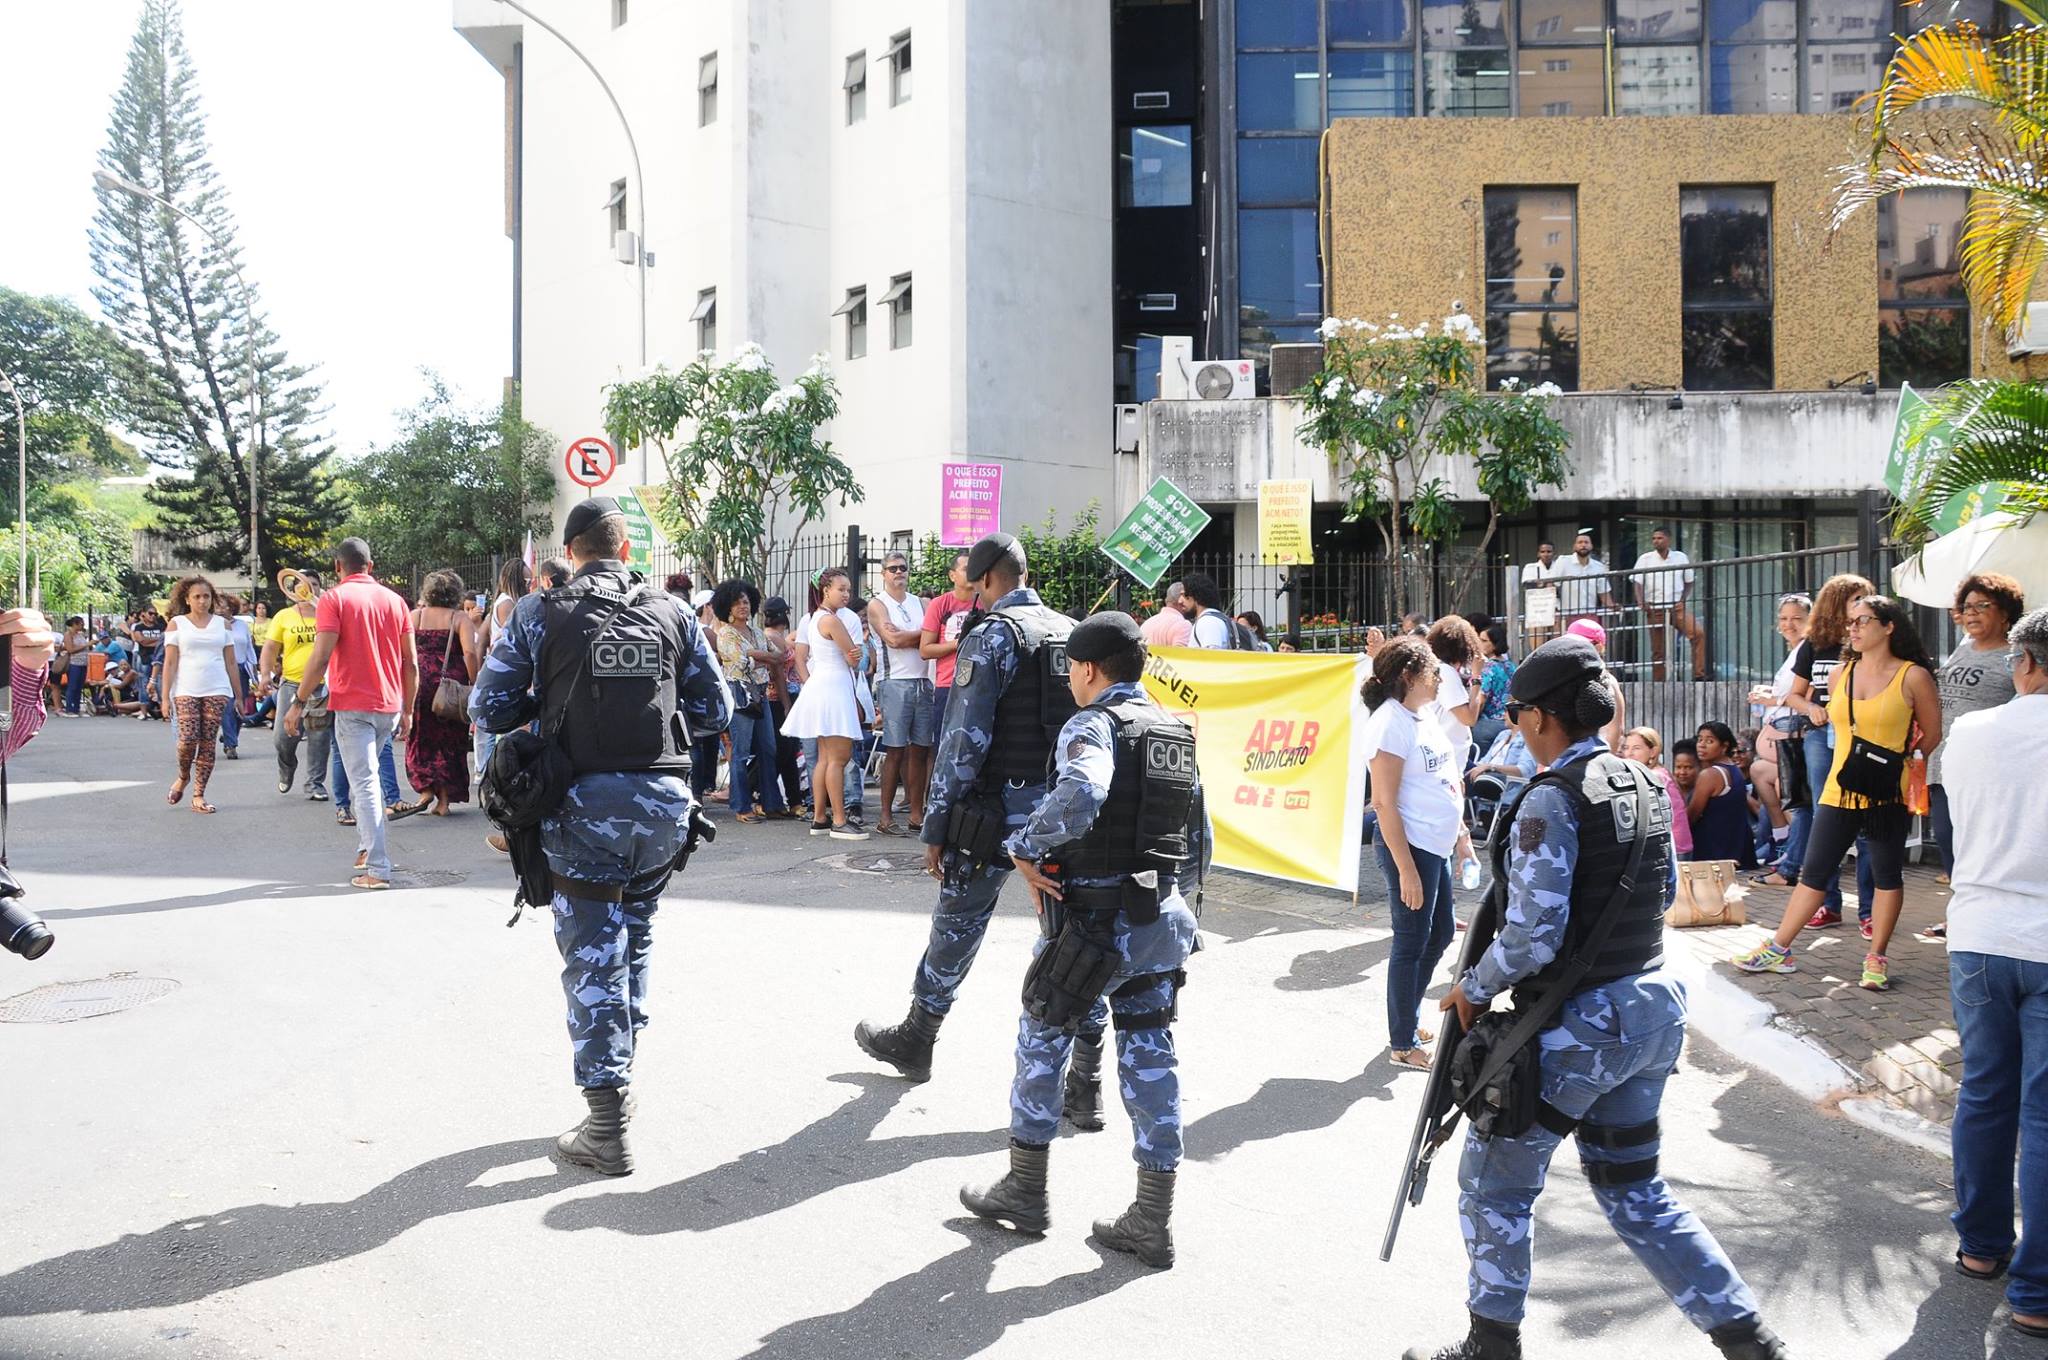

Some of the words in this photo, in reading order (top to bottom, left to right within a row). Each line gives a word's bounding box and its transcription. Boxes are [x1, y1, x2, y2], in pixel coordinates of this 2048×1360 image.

[581, 448, 605, 476] E
[946, 467, 953, 476] O
[954, 467, 971, 477] QUE
[979, 467, 998, 478] ISSO
[953, 479, 989, 489] PREFEITO
[1165, 494, 1192, 517] SOU
[1128, 521, 1172, 560] RESPEITO!
[1141, 512, 1176, 544] MEREÇO
[594, 643, 659, 669] GOE
[1937, 666, 1985, 687] RIS
[1244, 719, 1321, 757] APLB
[1149, 741, 1193, 773] GOE
[1243, 746, 1309, 773] SINDICATO
[1615, 795, 1663, 829] GE
